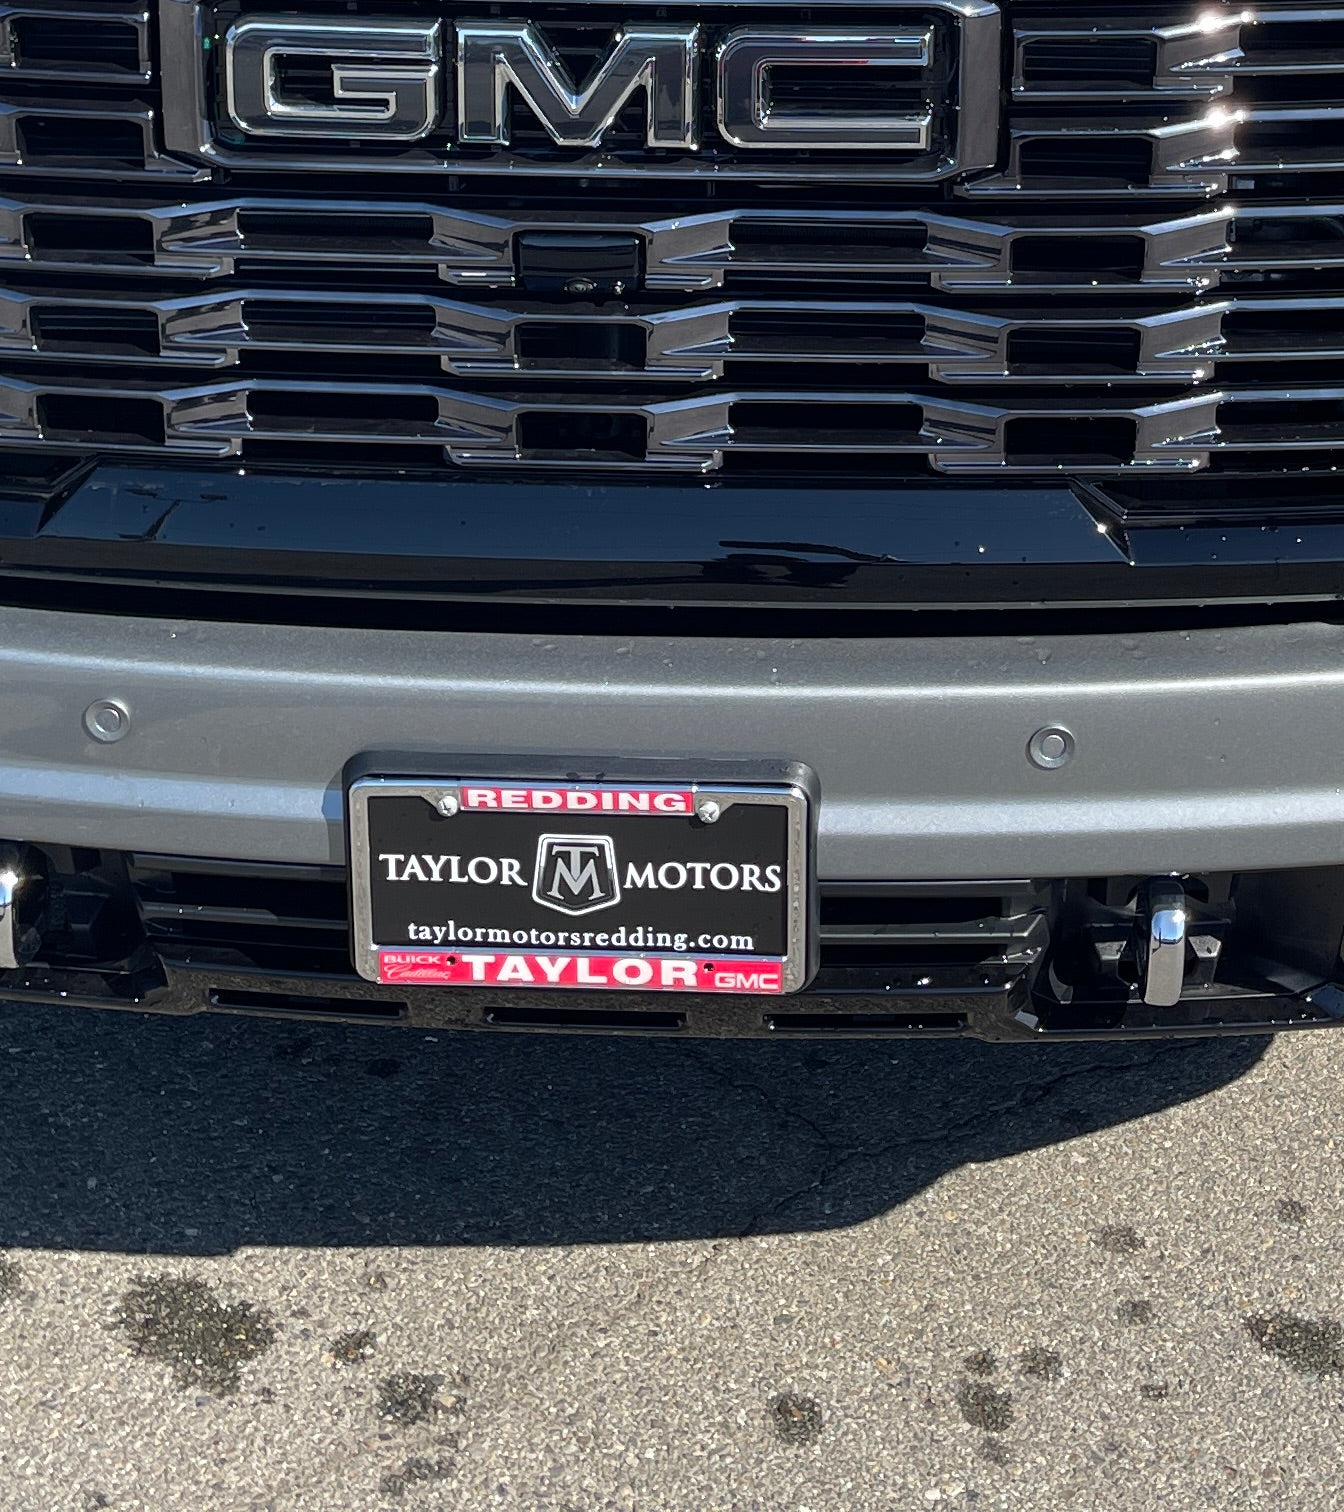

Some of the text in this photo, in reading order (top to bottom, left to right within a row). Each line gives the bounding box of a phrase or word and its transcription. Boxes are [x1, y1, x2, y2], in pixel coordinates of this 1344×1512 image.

[225, 17, 934, 151] GMC
[467, 789, 687, 811] REDDING
[378, 854, 528, 887] TAYLOR
[623, 862, 782, 892] MOTORS
[408, 922, 754, 950] taylormotorsredding.com
[383, 954, 441, 965] BUICK
[462, 954, 698, 986] TAYLOR
[713, 971, 779, 990] GMC
